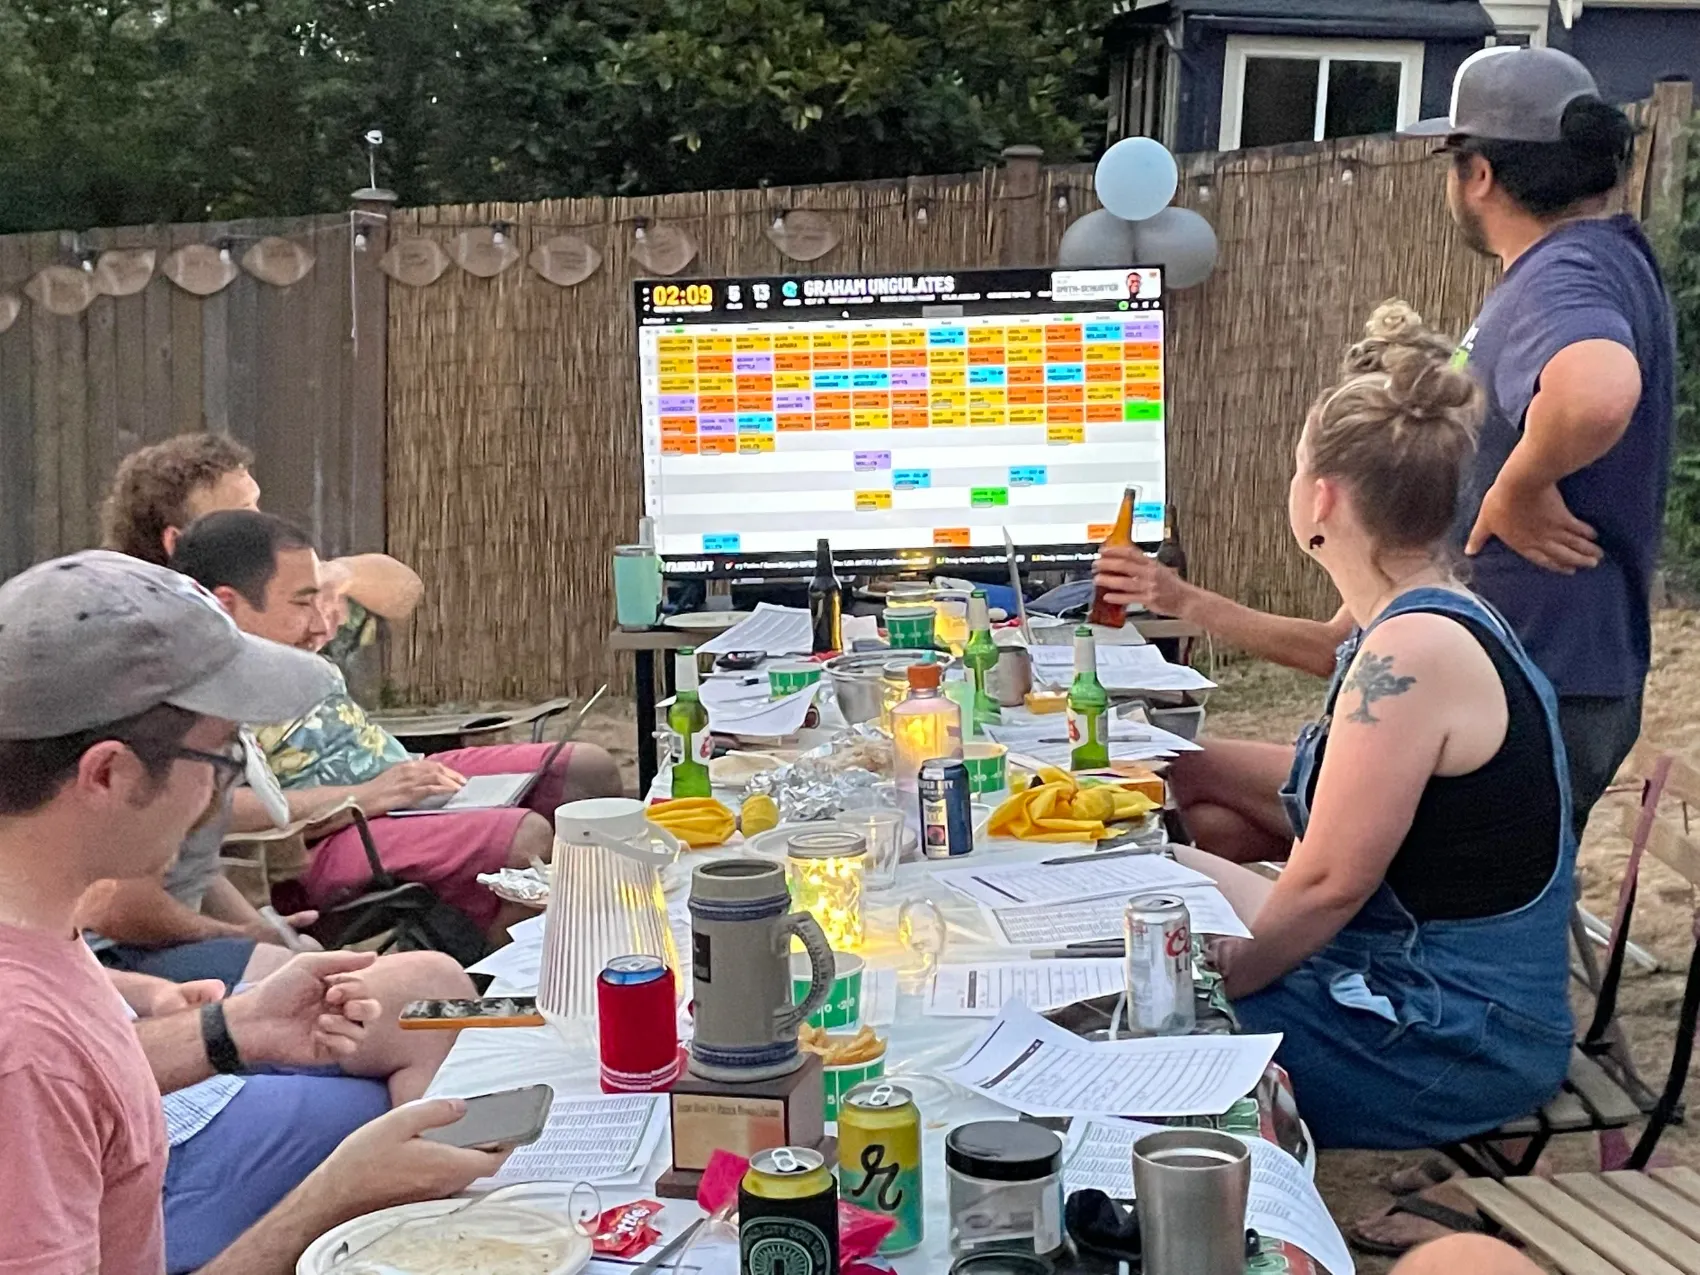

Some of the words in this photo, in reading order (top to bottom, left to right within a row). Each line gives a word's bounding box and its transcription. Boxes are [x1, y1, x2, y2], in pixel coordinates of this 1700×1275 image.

[653, 284, 713, 306] 02:09
[803, 278, 867, 297] GRAHAM
[868, 275, 955, 294] UNGULATES
